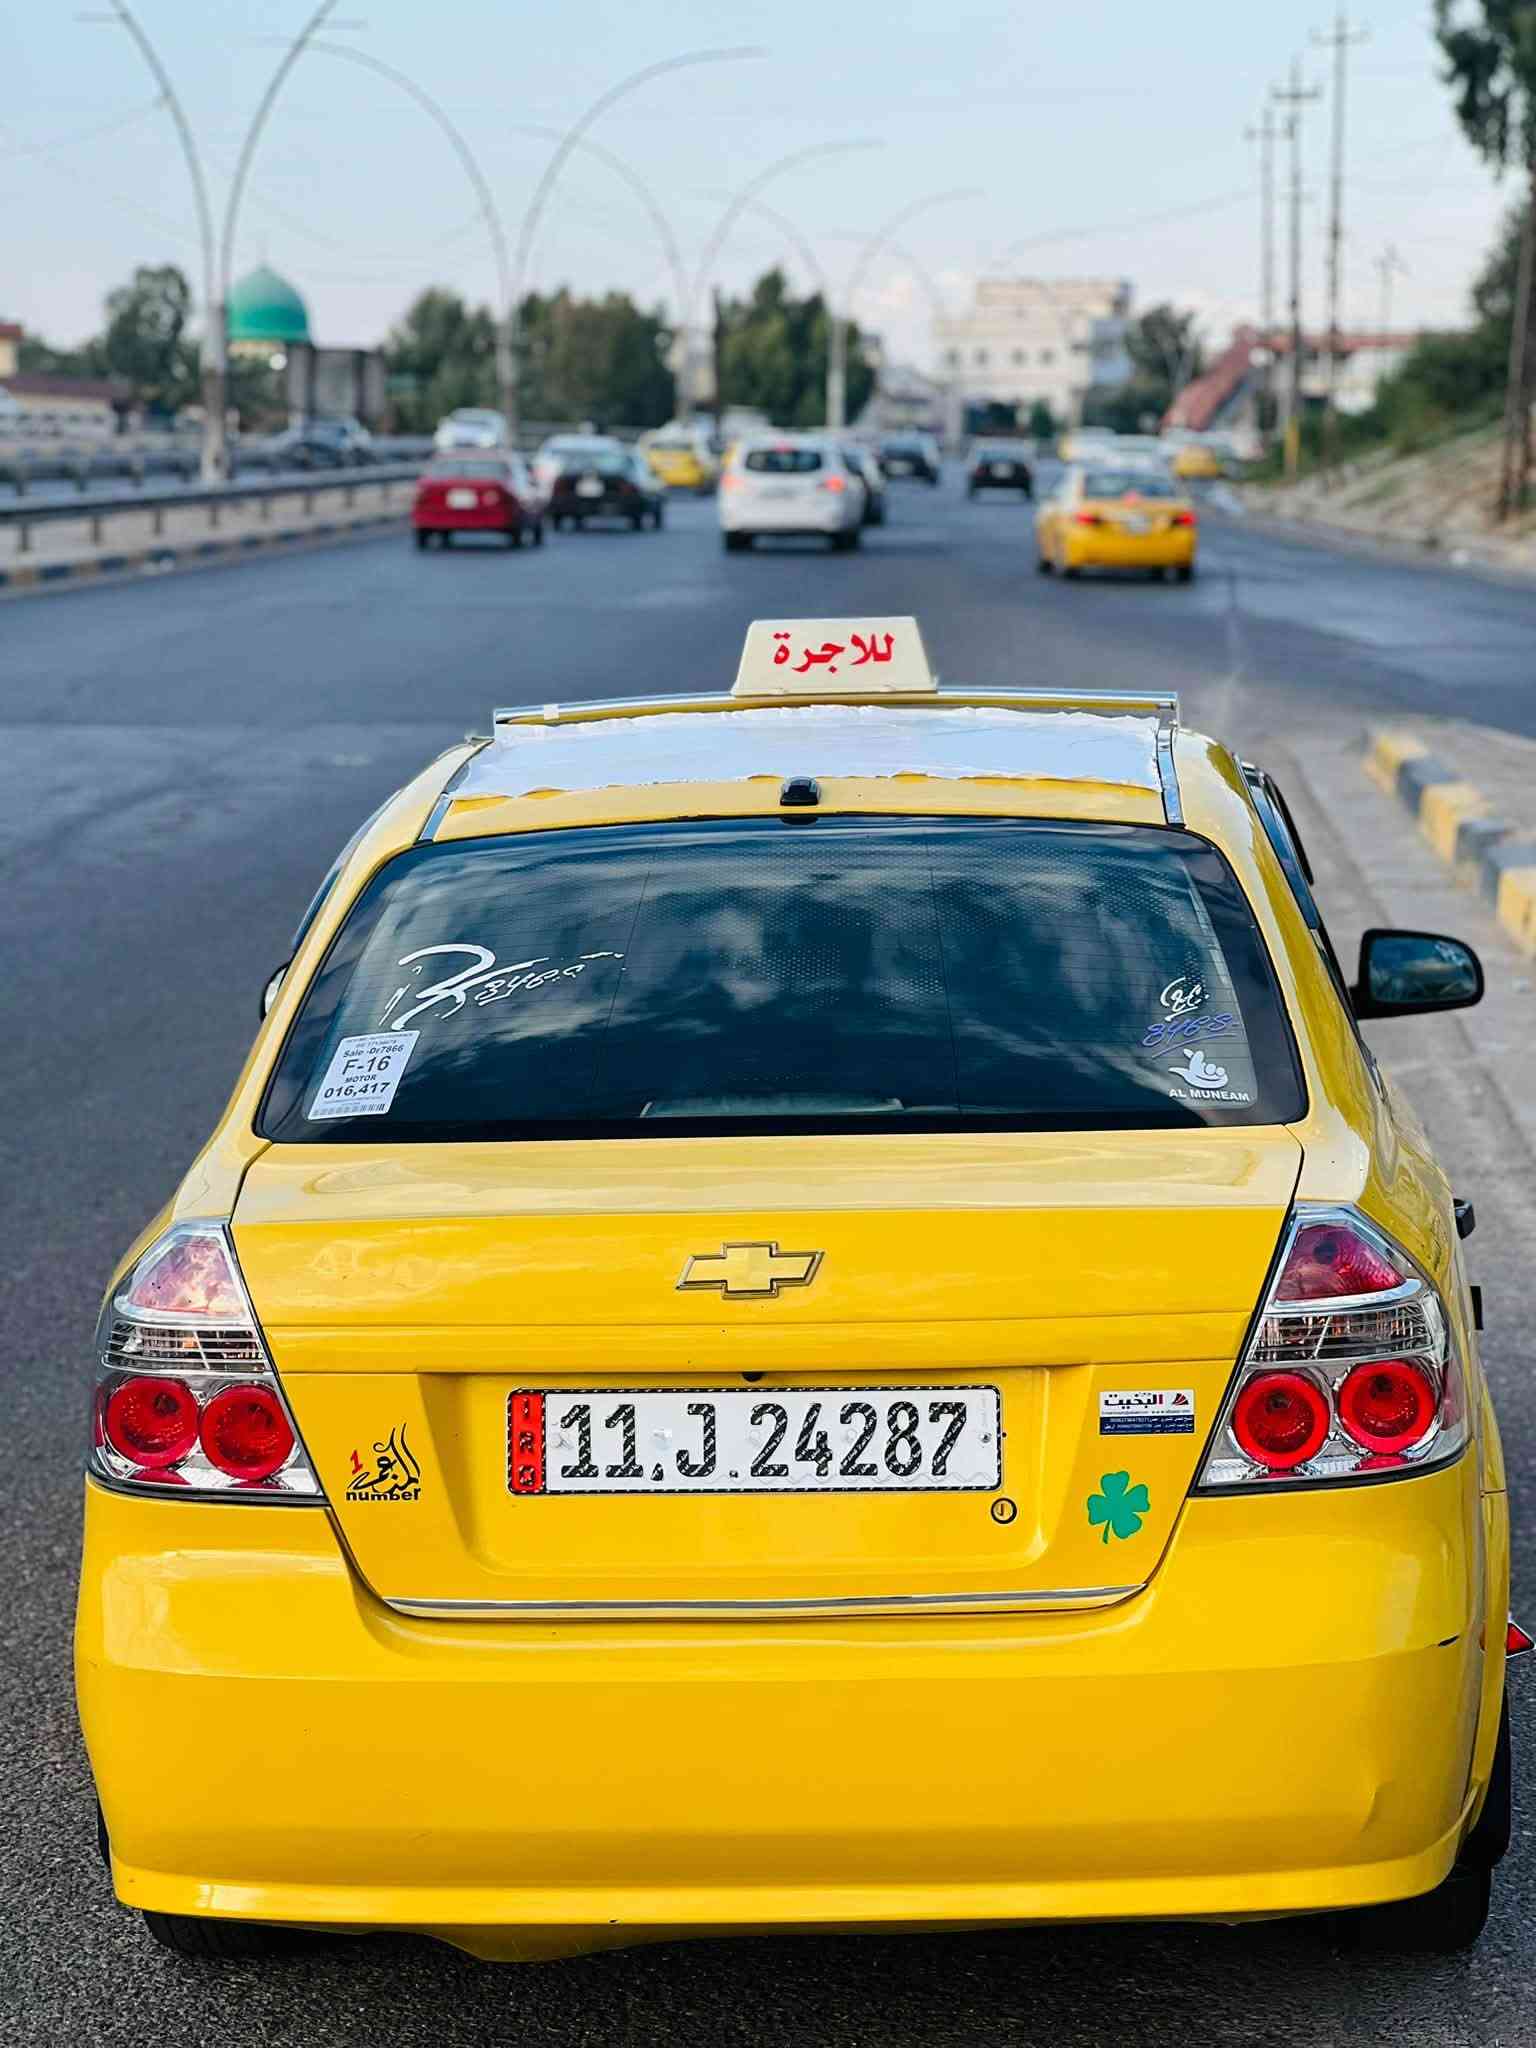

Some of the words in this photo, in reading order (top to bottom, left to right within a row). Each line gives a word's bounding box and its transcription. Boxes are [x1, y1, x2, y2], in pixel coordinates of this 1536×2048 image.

[772, 631, 896, 674] للاجرة
[342, 1054, 392, 1076] F-16
[343, 1073, 378, 1084] MOTOR
[323, 1081, 391, 1100] 016,417
[1168, 1088, 1187, 1098] AL
[1189, 1088, 1251, 1102] MUNEAM
[349, 1448, 364, 1475] 1
[345, 1487, 422, 1501] number
